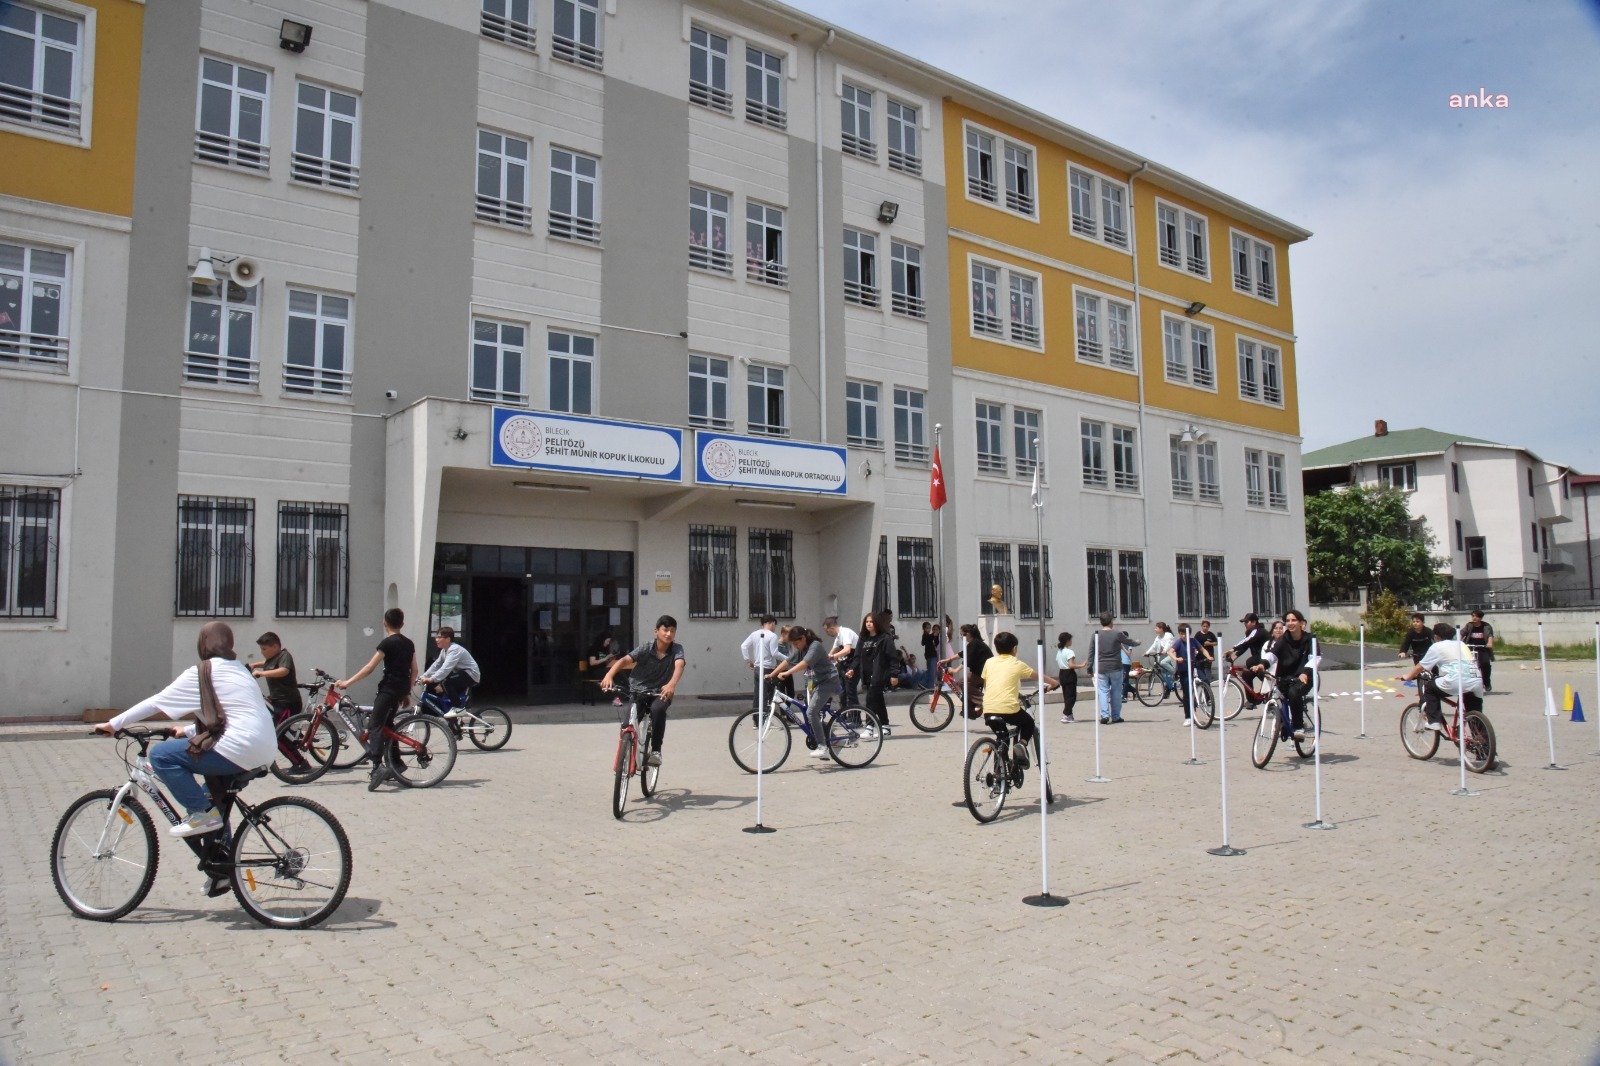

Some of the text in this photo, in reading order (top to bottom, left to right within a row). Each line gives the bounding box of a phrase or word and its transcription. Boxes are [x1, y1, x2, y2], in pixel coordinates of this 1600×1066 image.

[545, 426, 570, 436] BİLECİK
[545, 437, 585, 449] PELİTÖZÜ
[545, 446, 665, 466] ŞEHİT MÜNİR KOPUK İLKOKULU
[738, 448, 758, 457] BİLECİK
[738, 458, 770, 468] PELİTÖZÜ
[738, 466, 841, 482] ŞEHİT MÜNİR KOPUK ORTAOKULU
